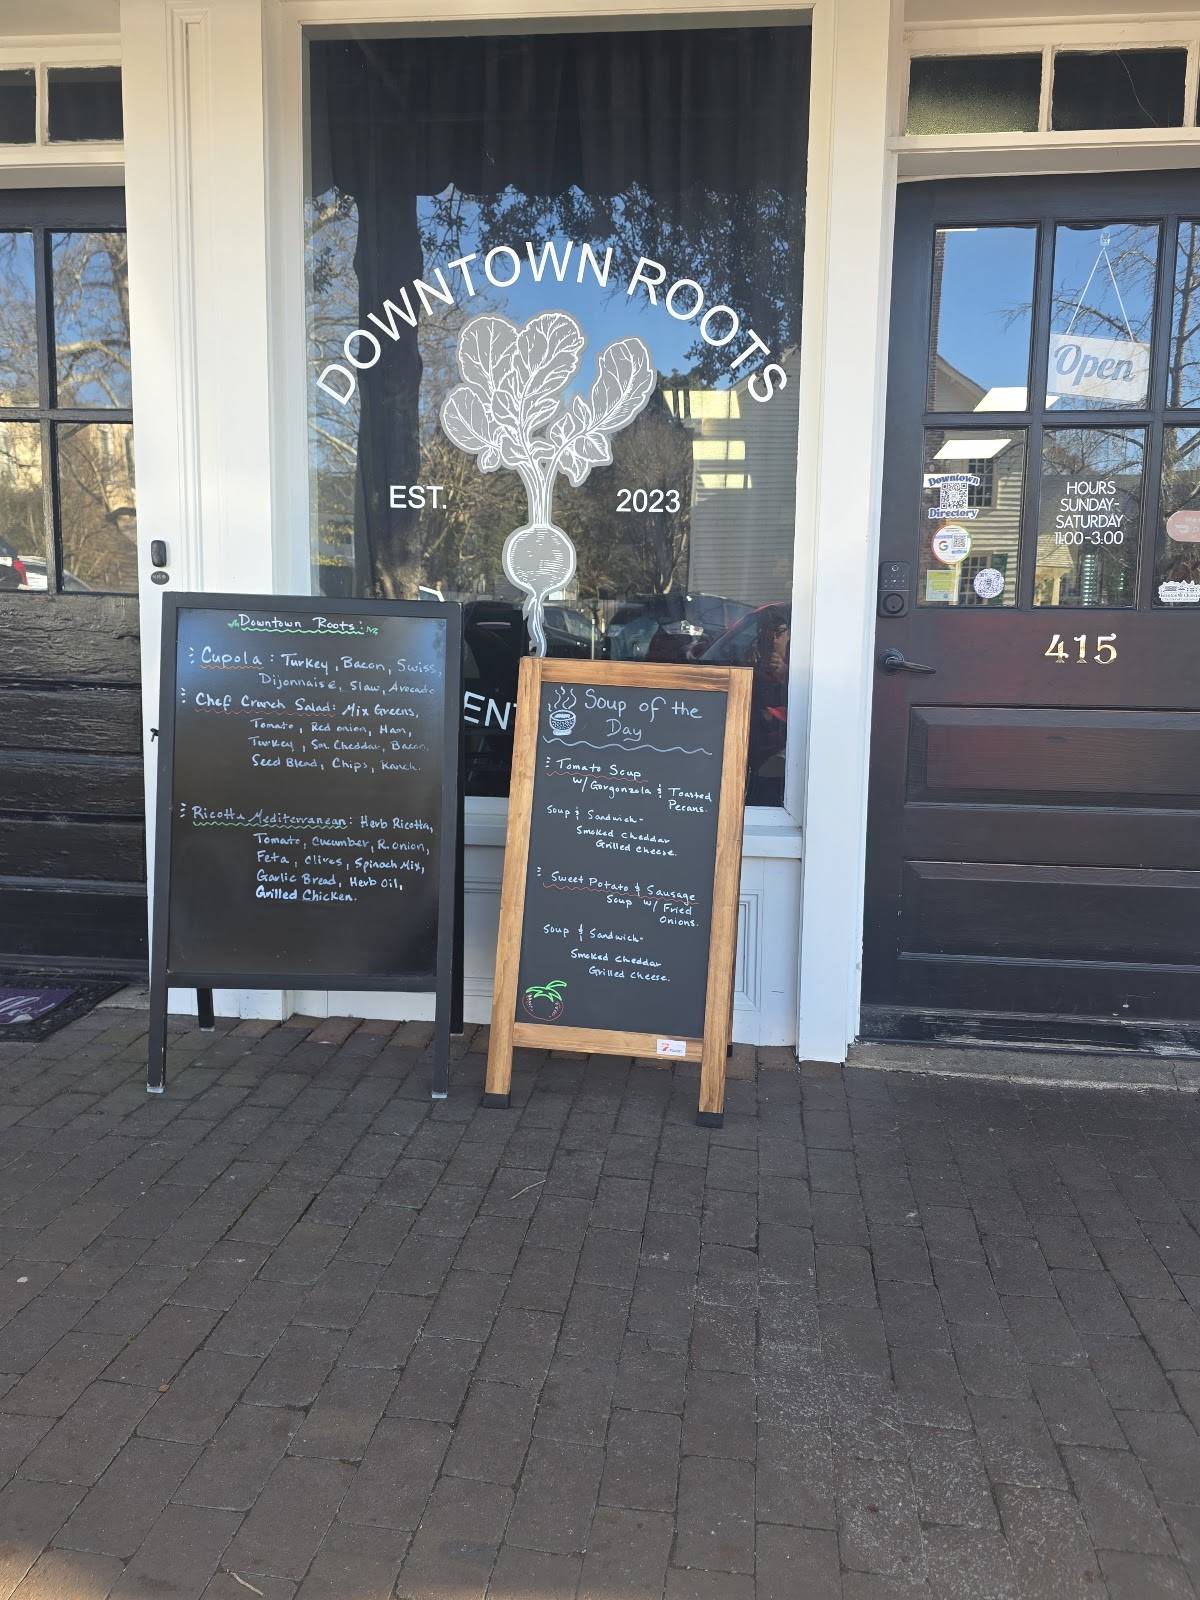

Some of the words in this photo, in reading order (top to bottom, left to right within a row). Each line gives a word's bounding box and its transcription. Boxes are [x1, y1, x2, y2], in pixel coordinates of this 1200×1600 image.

[315, 241, 614, 405] DOWNTOWN
[627, 257, 788, 402] ROOTS
[1053, 343, 1135, 387] Open
[928, 474, 979, 486] Downtown
[1066, 481, 1116, 495] HOURS
[389, 485, 447, 509] EST.
[615, 488, 681, 513] 2023
[1060, 498, 1120, 511] SUNDAY-
[929, 508, 977, 518] Directory
[1055, 514, 1124, 528] SATURDAY
[238, 613, 302, 628] Downtown
[1044, 633, 1117, 664] 415
[195, 692, 232, 711] Chef
[342, 703, 369, 717] Mix
[585, 688, 626, 717] Soup
[639, 696, 666, 722] of
[671, 700, 703, 718] the
[311, 722, 331, 732] Red
[606, 718, 642, 741] Day
[251, 753, 281, 767] Seed
[555, 758, 601, 772] Tomato
[609, 764, 641, 780] Soup
[668, 787, 712, 802] Toasted
[192, 805, 246, 820] Ricotta
[360, 815, 388, 829] Herb
[546, 805, 571, 819] Soup
[576, 825, 614, 838] Smoked
[595, 839, 631, 852] Grilled
[354, 857, 397, 873] Spinach
[257, 868, 297, 883] Garlic
[349, 876, 377, 888] Herb
[255, 885, 298, 900] Grilled
[551, 871, 584, 884] Sweet
[588, 877, 629, 892] Potato
[646, 884, 696, 906] Sausage
[606, 894, 633, 909] Soup
[663, 903, 692, 915] Fried
[543, 924, 570, 938] Soup
[570, 948, 609, 962] Smoked
[588, 966, 625, 978] Grilled
